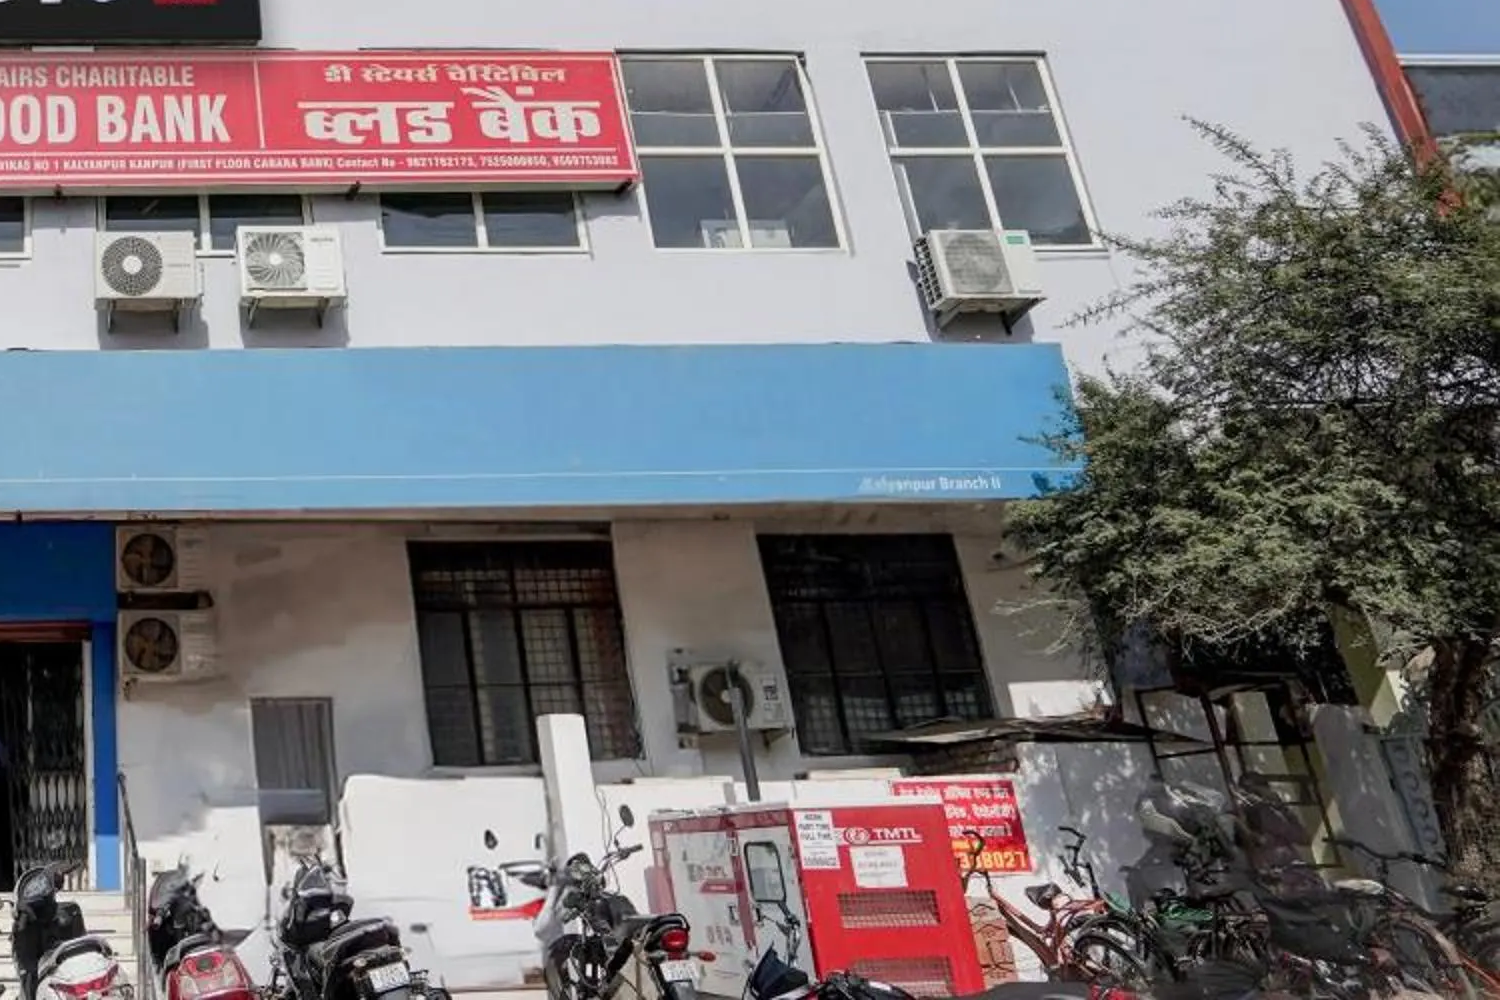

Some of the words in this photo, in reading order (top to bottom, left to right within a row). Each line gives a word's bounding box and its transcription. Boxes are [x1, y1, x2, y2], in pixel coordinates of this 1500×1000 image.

[56, 65, 195, 88] CHARITABLE
[95, 93, 232, 144] BANK
[461, 86, 601, 143] बैंक
[337, 157, 378, 168] Contact
[939, 476, 988, 489] Branch
[872, 827, 923, 840] TMTL
